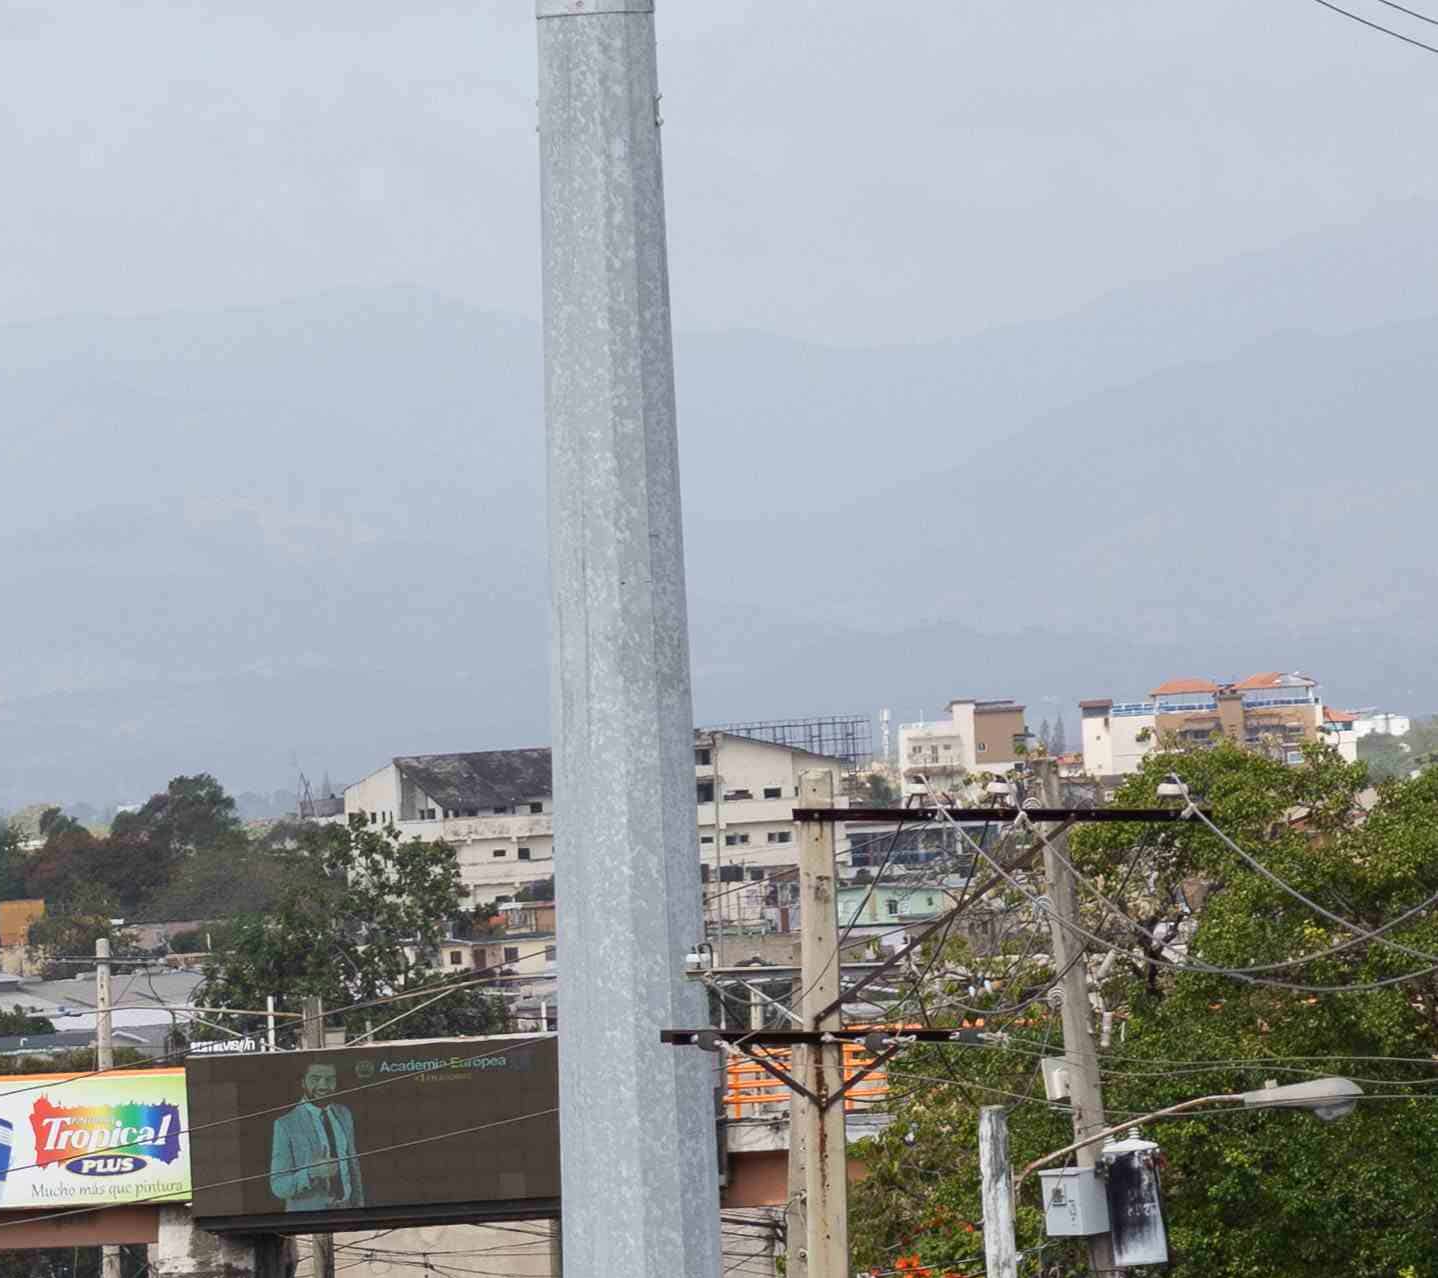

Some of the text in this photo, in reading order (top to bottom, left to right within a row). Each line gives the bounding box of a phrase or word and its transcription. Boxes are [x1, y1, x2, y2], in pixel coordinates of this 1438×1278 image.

[379, 1055, 506, 1073] Academia Europea
[43, 1115, 172, 1153] Tropical
[82, 1159, 134, 1173] PLUS
[32, 1180, 183, 1199] Mucho más que pintura
